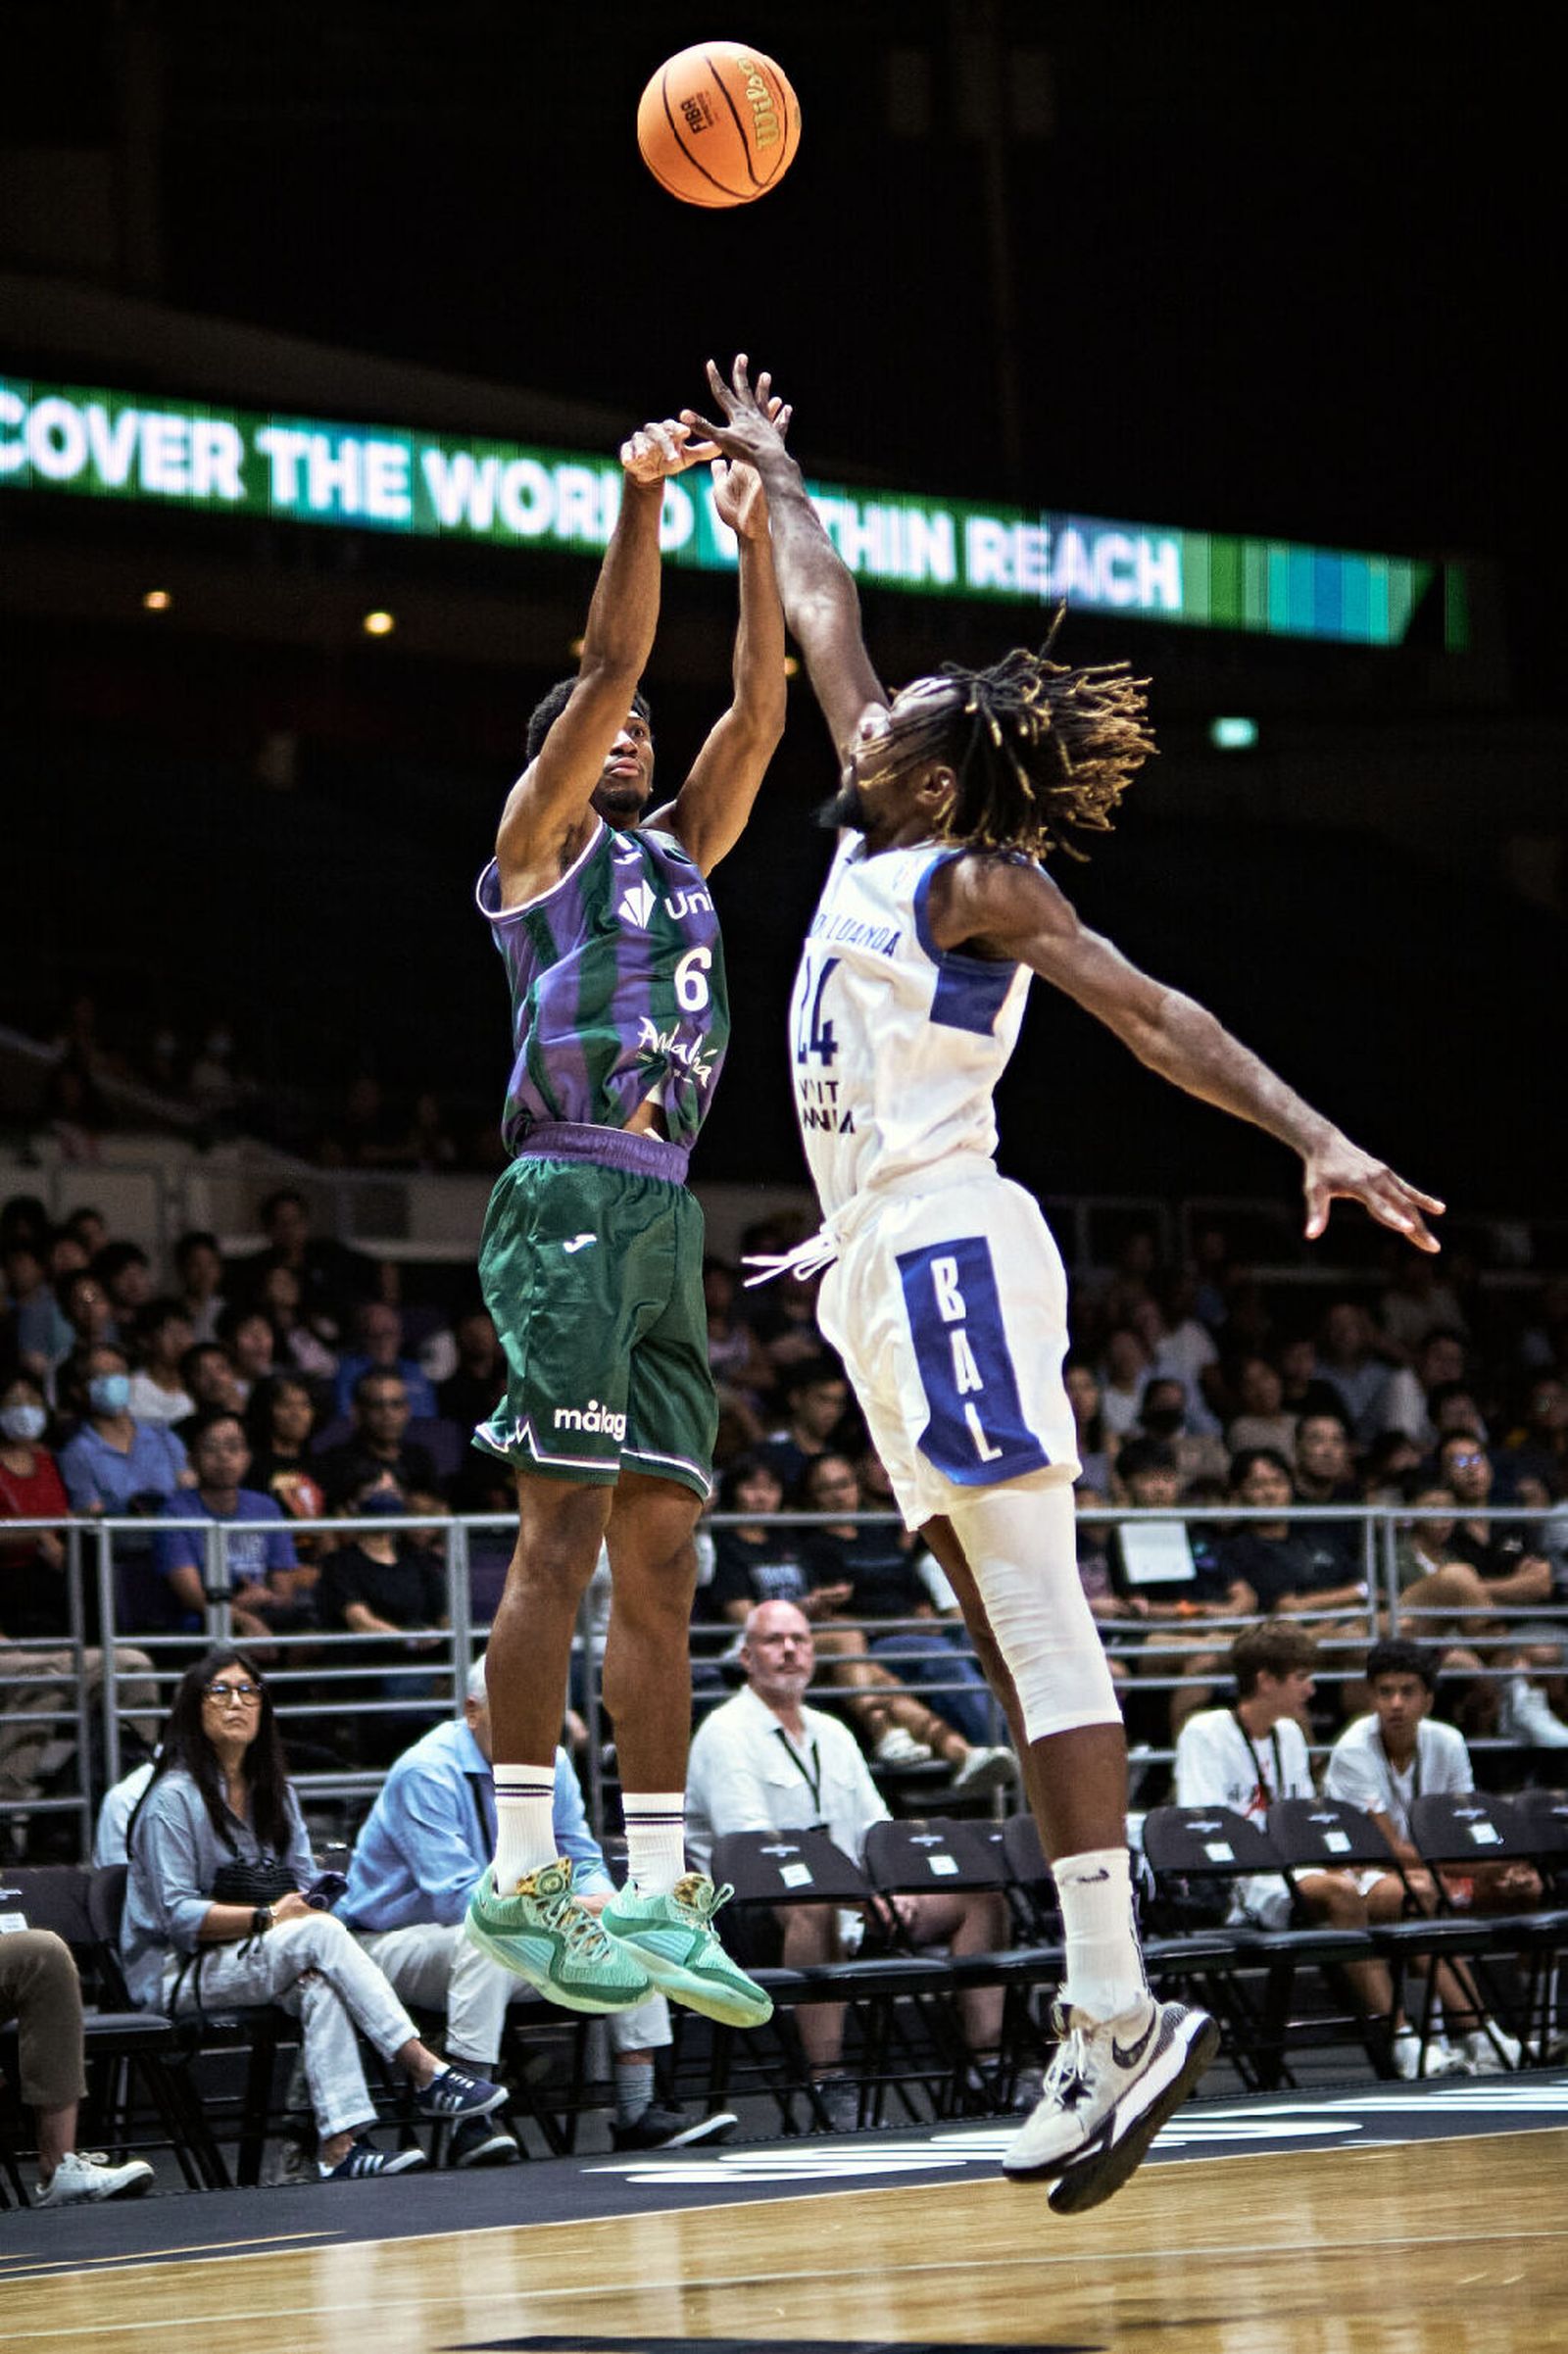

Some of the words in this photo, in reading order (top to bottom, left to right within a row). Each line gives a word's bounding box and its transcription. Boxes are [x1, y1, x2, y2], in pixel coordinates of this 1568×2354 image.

[680, 96, 708, 134] FIBA
[255, 424, 411, 521] THE
[964, 515, 1183, 612] REACH
[674, 947, 712, 1011] 6
[931, 1256, 1003, 1462] BAL
